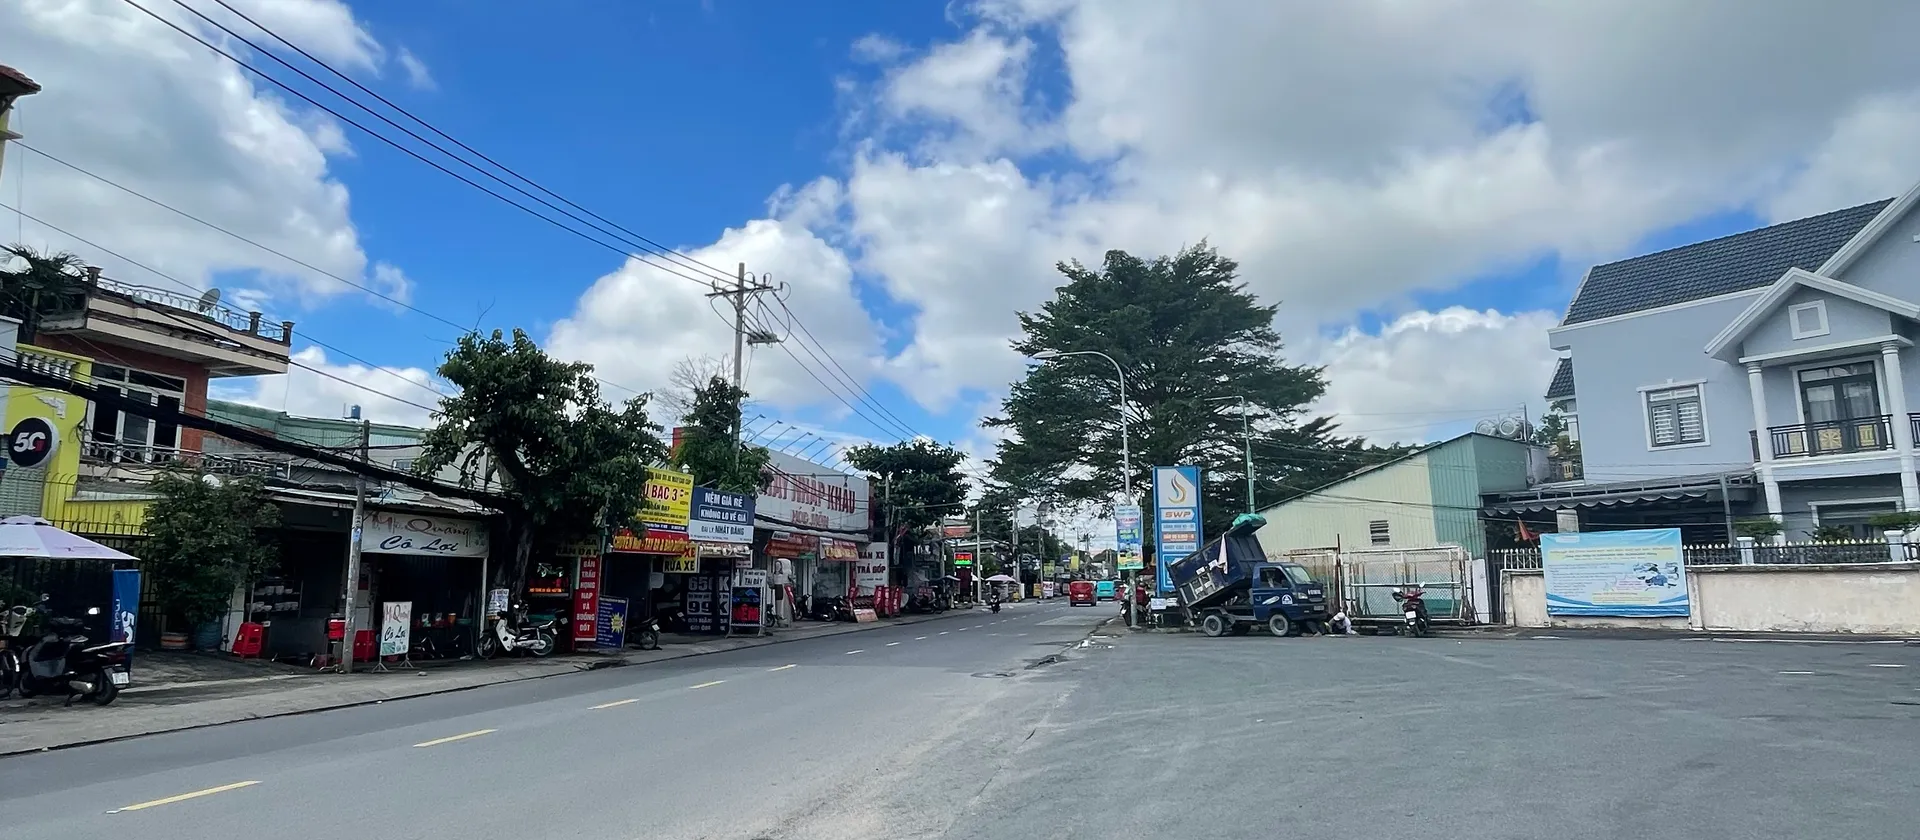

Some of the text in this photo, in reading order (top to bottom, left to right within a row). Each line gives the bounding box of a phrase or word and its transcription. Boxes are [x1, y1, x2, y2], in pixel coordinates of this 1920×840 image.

[704, 491, 743, 508] NỆM GIÁ RẺ
[700, 508, 721, 519] KHÔNG
[721, 512, 729, 520] LO
[715, 525, 730, 535] NHẬT
[379, 535, 459, 554] Cô Lợi
[875, 551, 885, 560] XE
[683, 560, 696, 572] XE
[857, 563, 886, 574] TRẢ GÓP
